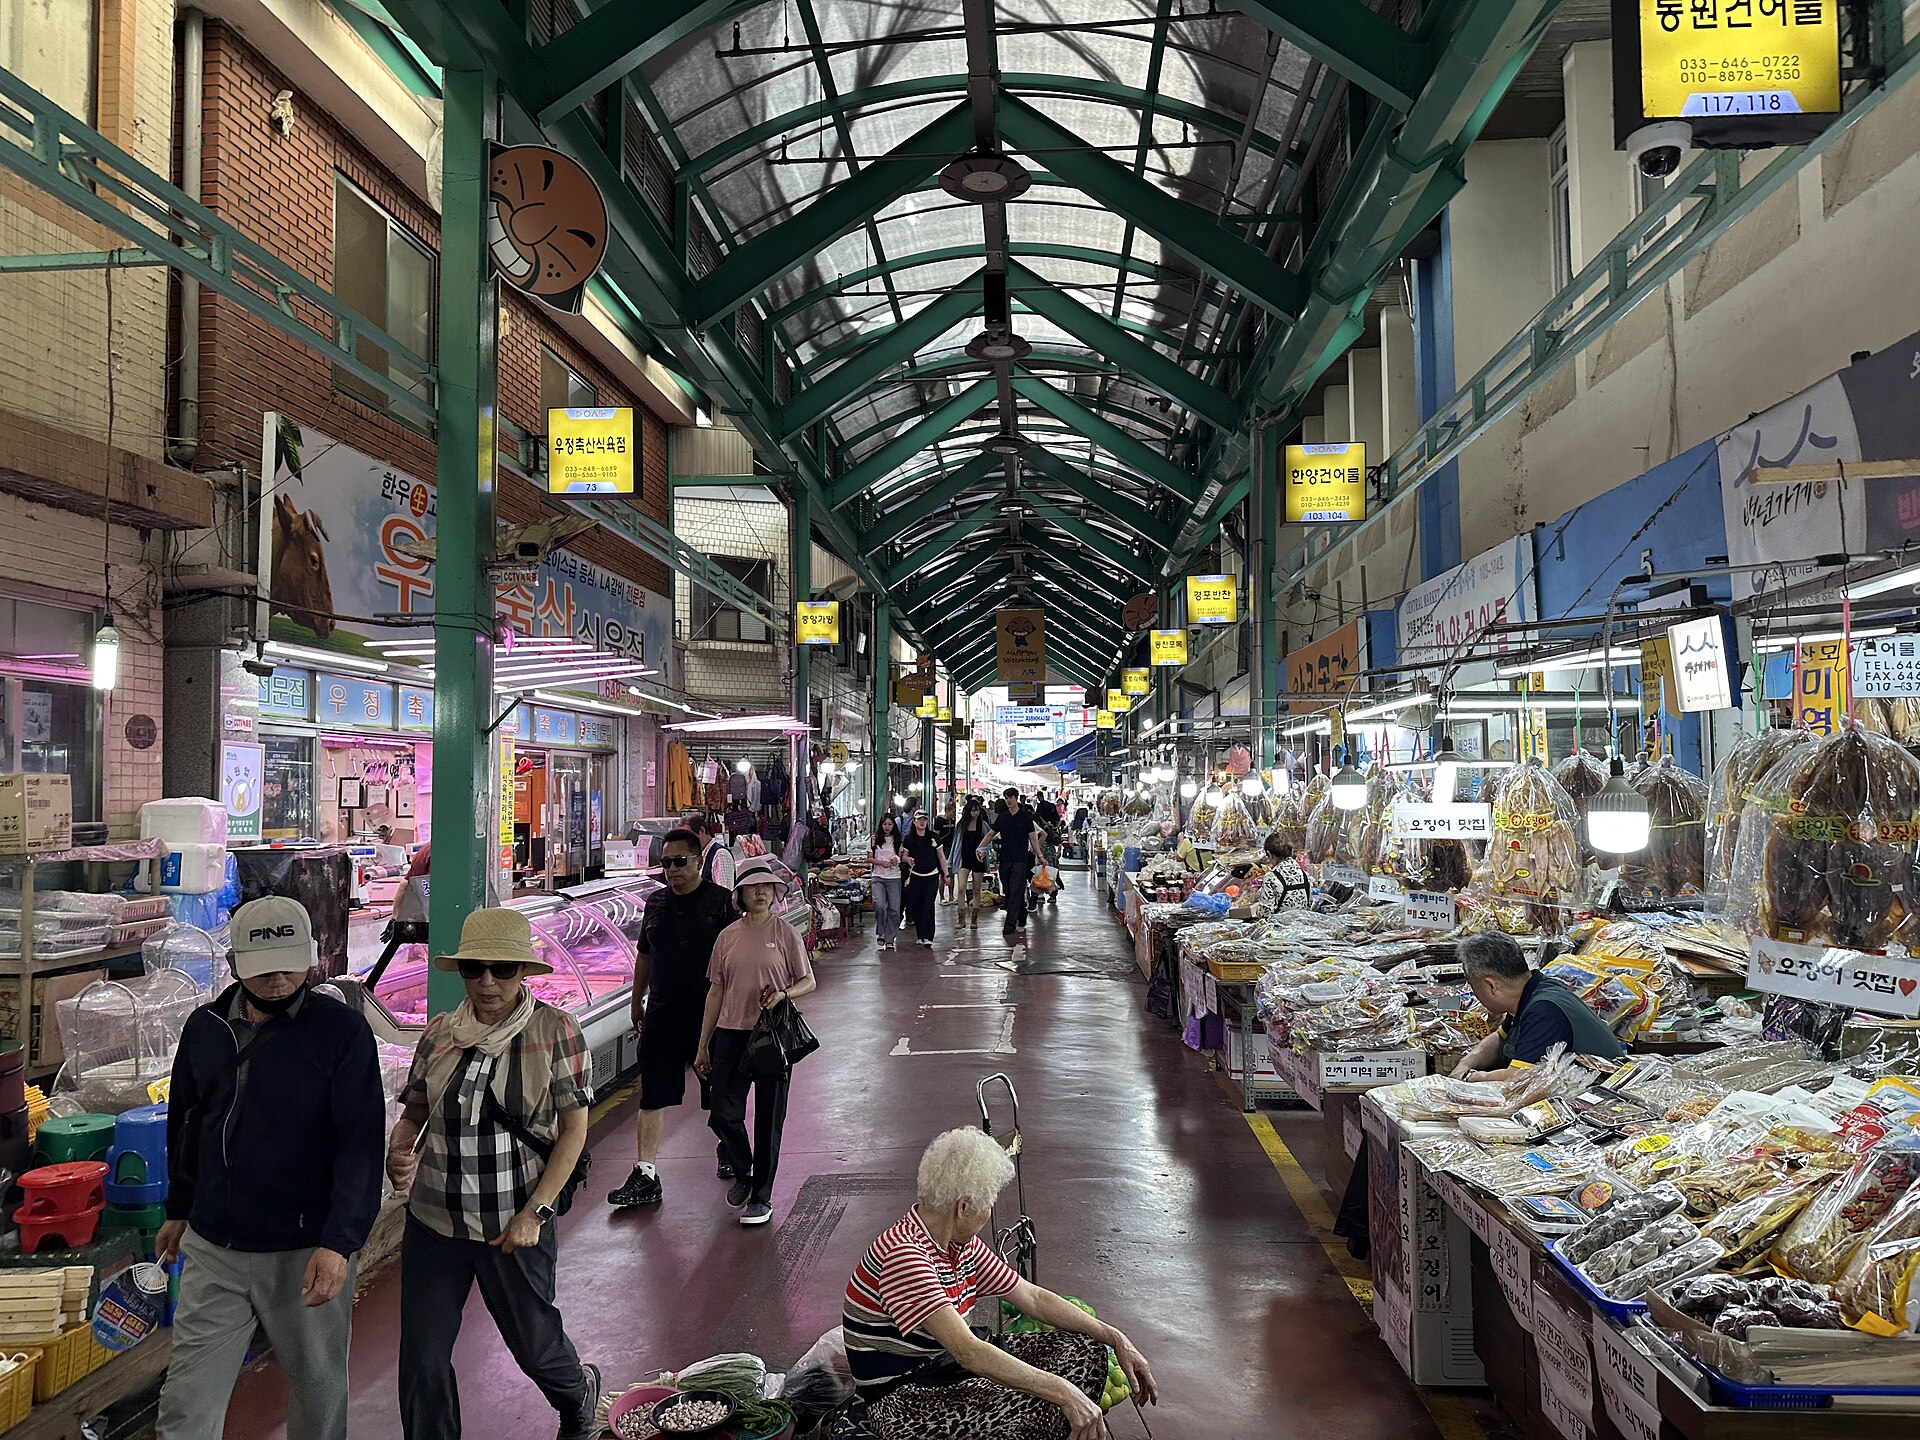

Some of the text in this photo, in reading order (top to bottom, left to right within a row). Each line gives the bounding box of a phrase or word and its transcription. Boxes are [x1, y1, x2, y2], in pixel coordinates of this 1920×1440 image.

[1656, 0, 1822, 32] 동원건어물
[1680, 56, 1800, 69] 033-646-0722
[1681, 69, 1801, 83] 010-8878-7350
[1702, 94, 1781, 113] 117, 118
[554, 436, 626, 455] 우정축산식육점
[1291, 467, 1360, 485] 한양건어물
[586, 483, 597, 492] 73
[600, 572, 626, 600] LA갈비
[626, 584, 647, 609] 전문점
[1193, 589, 1231, 601] 경포반찬
[801, 615, 834, 625] 중앙가방
[1410, 818, 1486, 832] 오징어 맛집
[1408, 893, 1450, 906] 동해바다
[1407, 909, 1451, 923] 배오징어
[249, 924, 295, 942] PING
[1775, 957, 1898, 995] 오징어 맛집
[1325, 1066, 1398, 1078] 한치 미역 멸치
[1498, 1230, 1519, 1268] 오징어
[1602, 1336, 1646, 1398] 거짓없는
